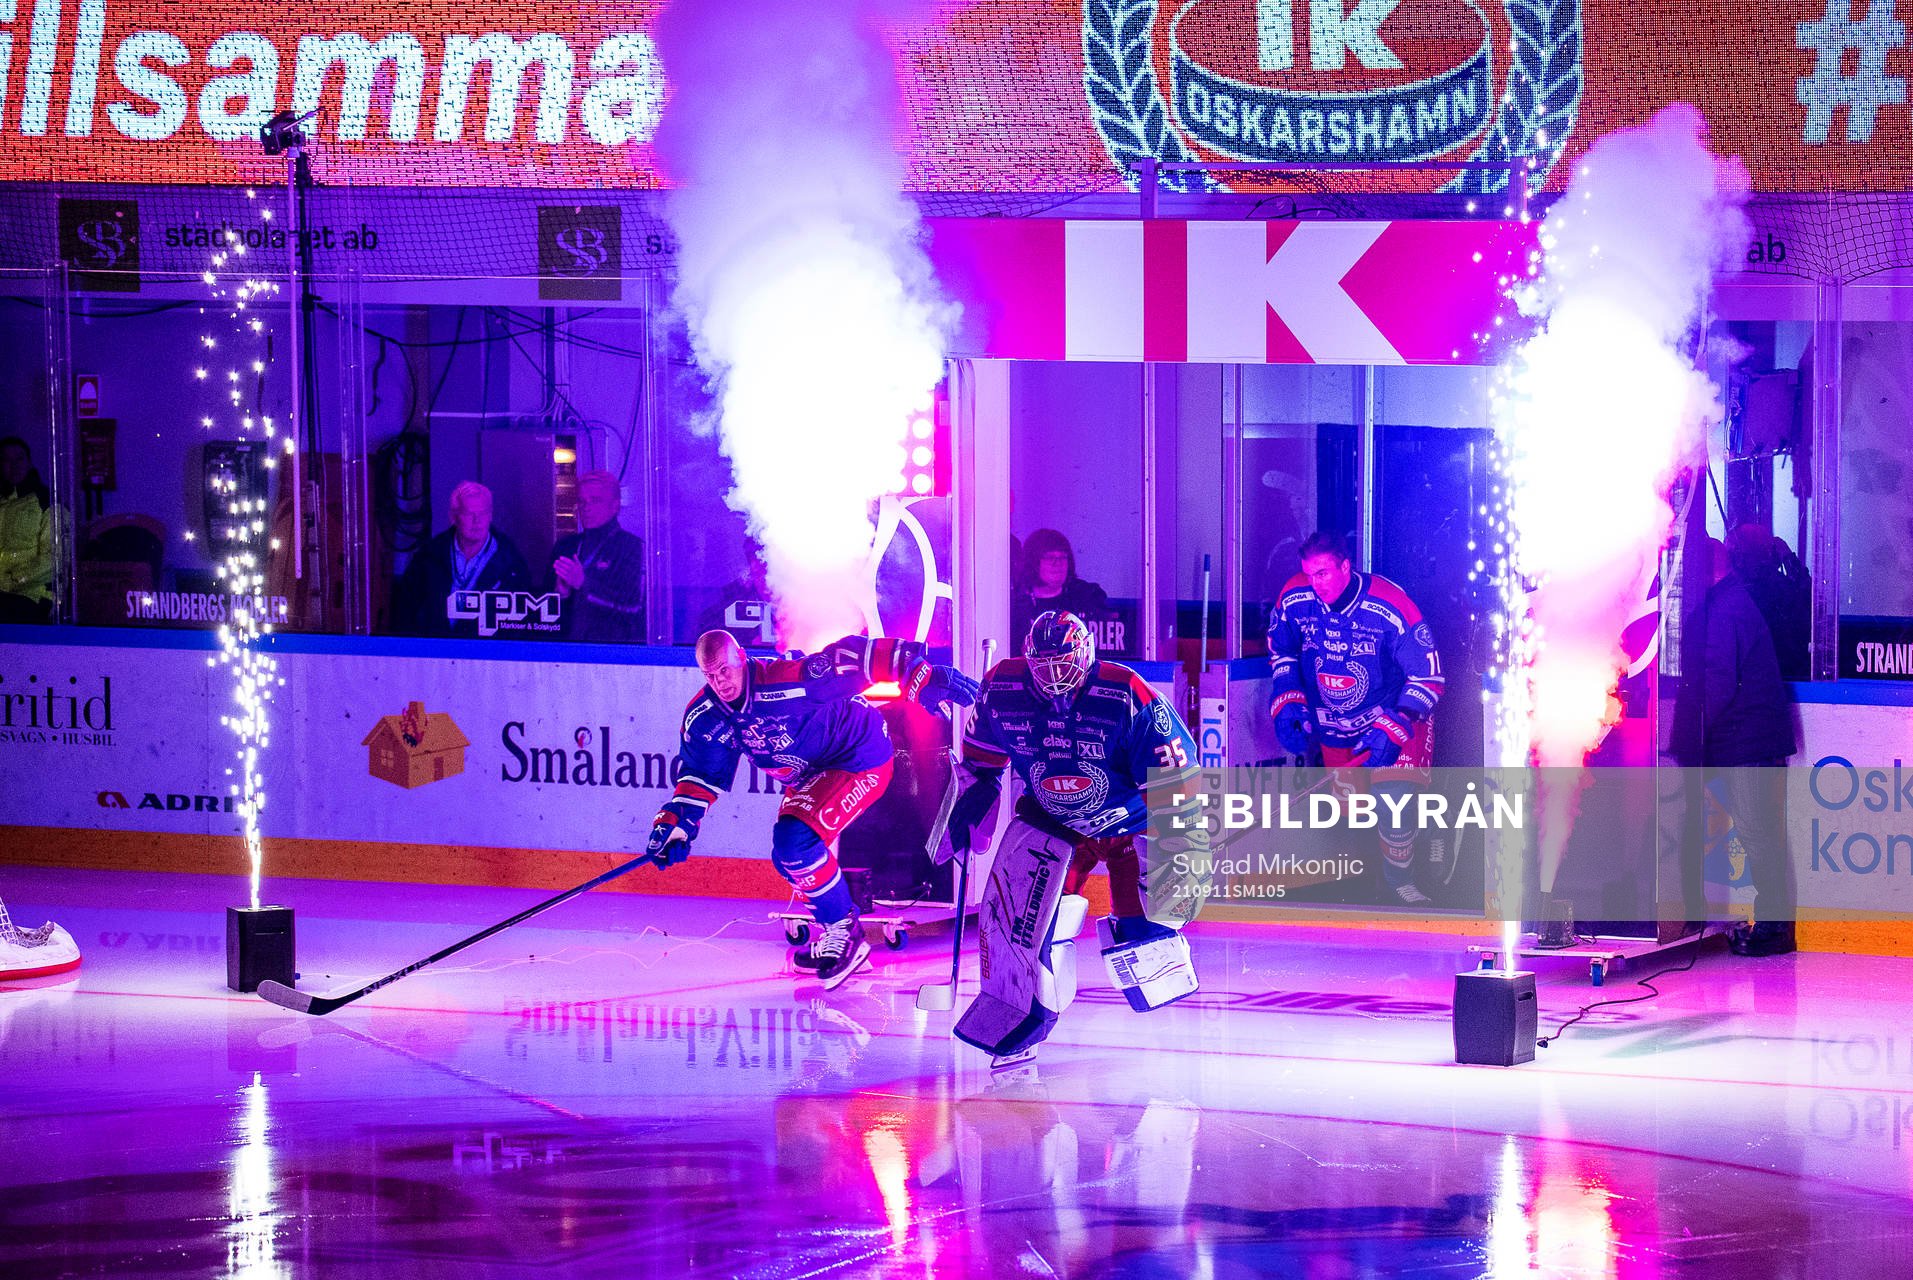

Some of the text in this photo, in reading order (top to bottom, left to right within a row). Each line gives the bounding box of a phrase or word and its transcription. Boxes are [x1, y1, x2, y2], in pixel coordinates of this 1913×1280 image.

[1257, 0, 1404, 71] IK
[1186, 79, 1476, 154] OSKARSHAMN
[343, 223, 377, 250] ab
[1747, 233, 1786, 263] ab
[1065, 220, 1406, 364] IK
[126, 590, 227, 622] STRANDBERGS
[1366, 603, 1392, 619] SCANIA
[534, 622, 561, 632] Solskydd
[1080, 613, 1125, 650] BLER
[1324, 676, 1345, 688] IK
[0, 674, 116, 731] ritid
[1154, 737, 1188, 773] 35
[1044, 788, 1094, 802] OSKARSHAMN
[1053, 778, 1080, 791] IK
[1809, 755, 1913, 813] Osk
[137, 791, 262, 814] ADRI
[1020, 866, 1051, 950] UTBILDNING
